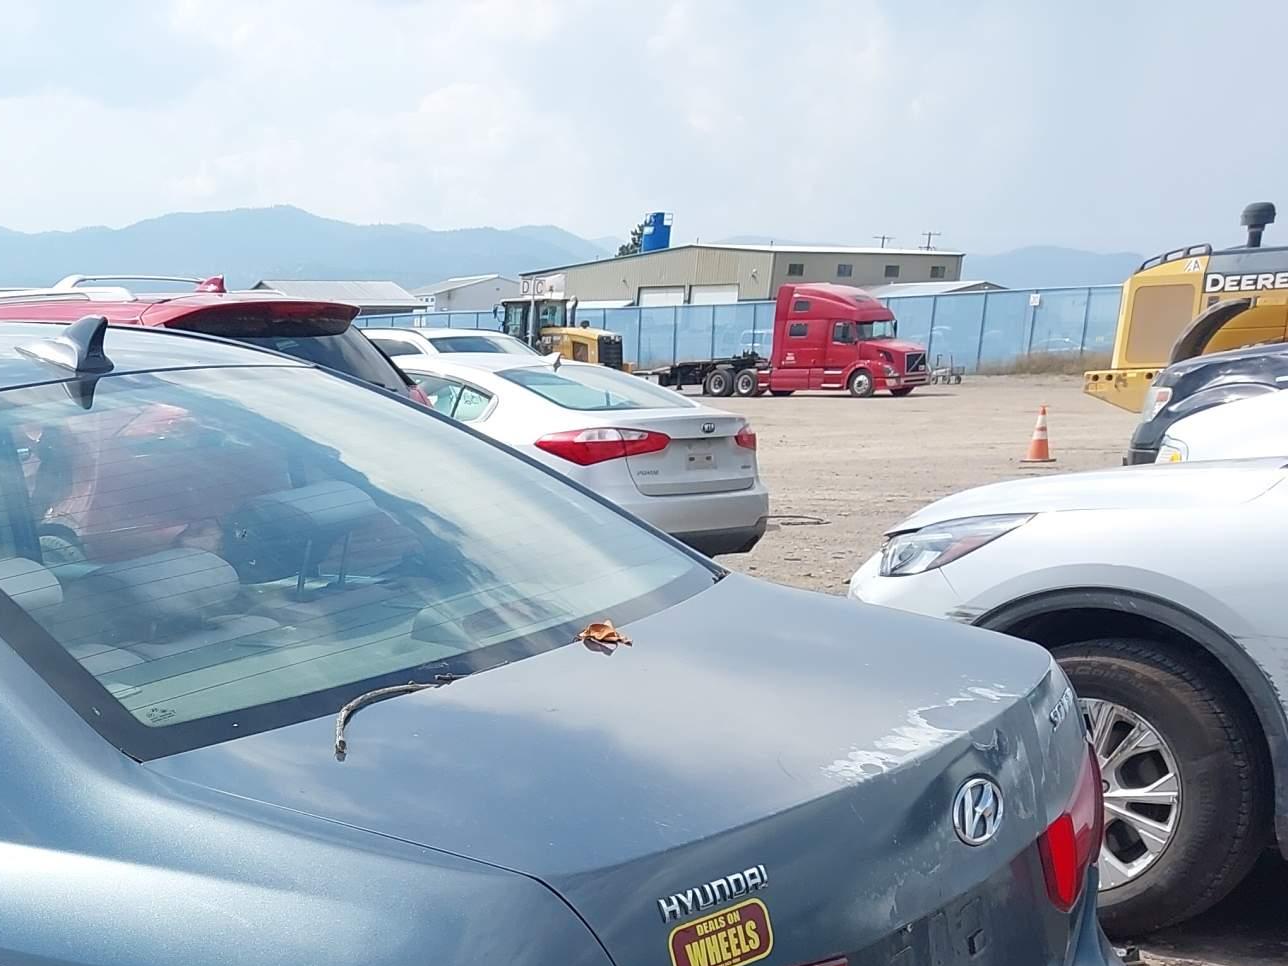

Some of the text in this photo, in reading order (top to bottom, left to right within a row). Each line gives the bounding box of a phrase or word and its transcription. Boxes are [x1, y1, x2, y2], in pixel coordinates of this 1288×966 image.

[1205, 273, 1288, 293] DEERE
[657, 864, 769, 924] HYUNDAI
[695, 910, 741, 936] DEALS ON
